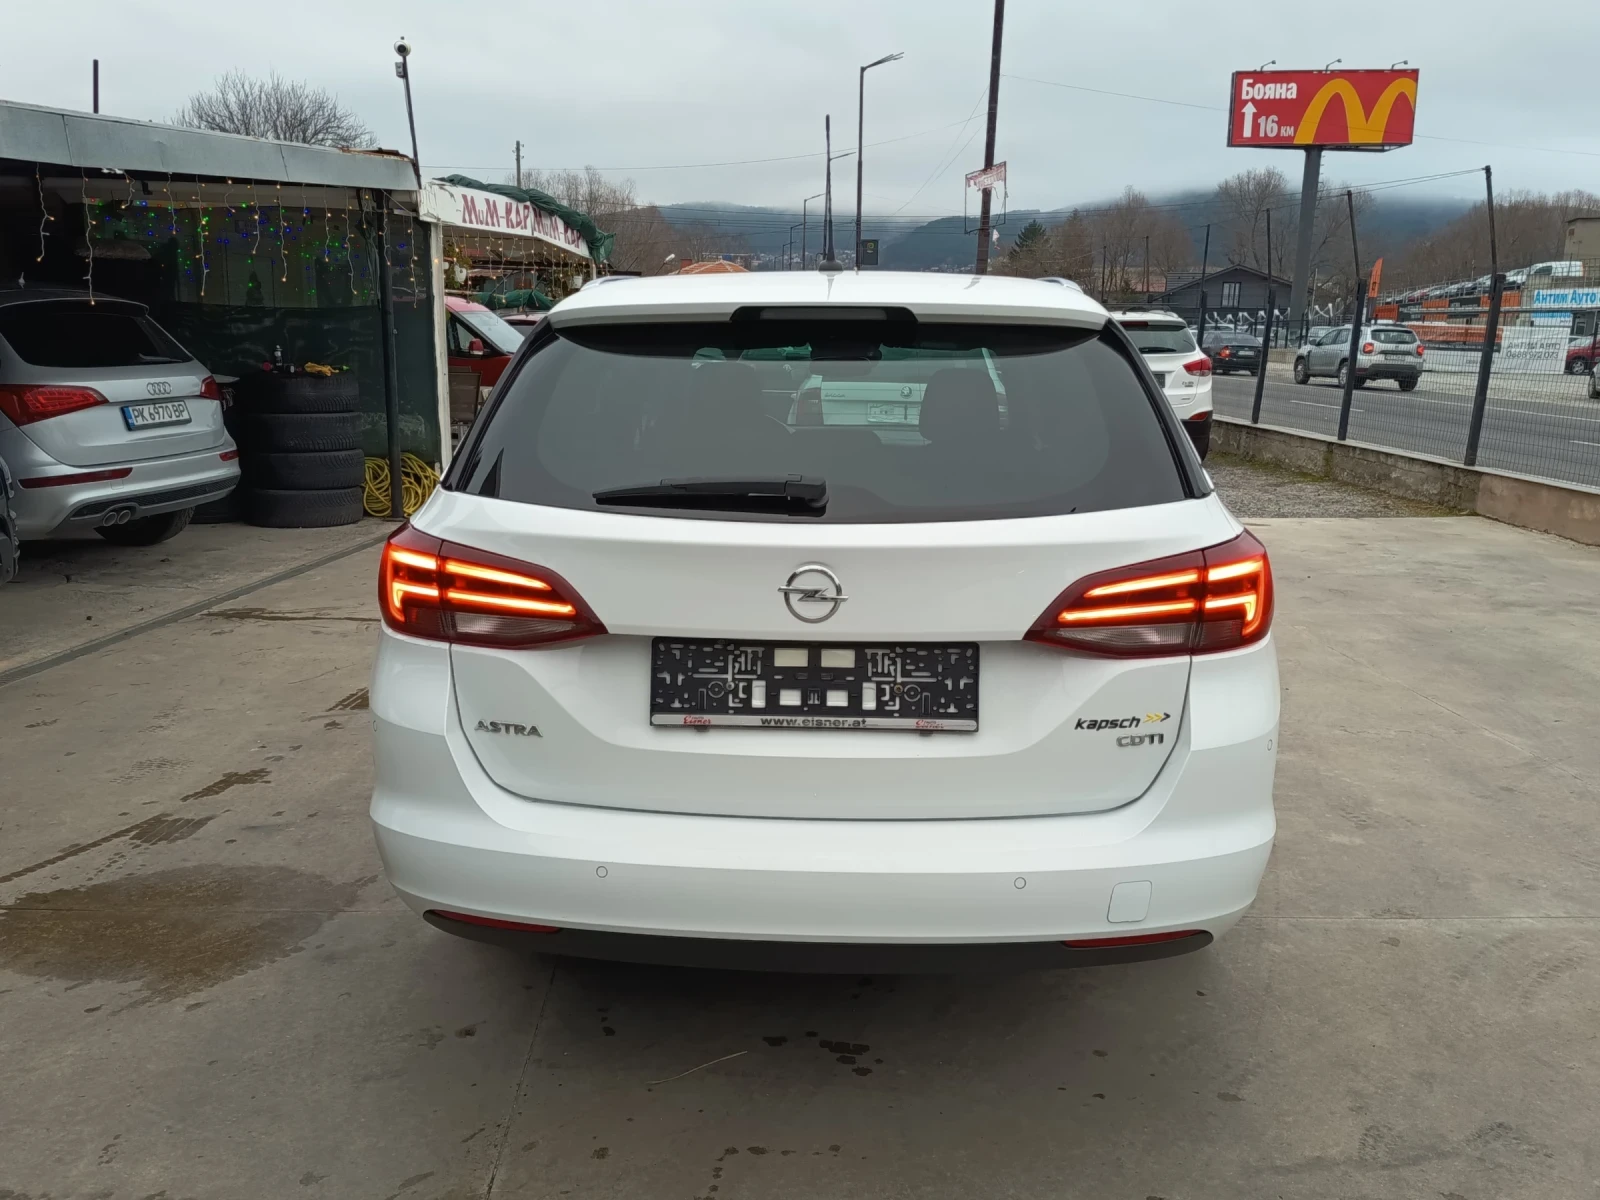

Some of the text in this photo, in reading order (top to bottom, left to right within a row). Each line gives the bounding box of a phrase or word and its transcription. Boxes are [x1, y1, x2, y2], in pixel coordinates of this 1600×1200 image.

[1241, 78, 1297, 100] Бояна
[1257, 115, 1279, 138] 16
[132, 403, 185, 423] PK 6970 BP
[474, 719, 543, 738] ASTRA
[760, 717, 867, 727] www.eisner.at
[1074, 716, 1141, 731] kapsch
[1116, 733, 1164, 747] CDTI
